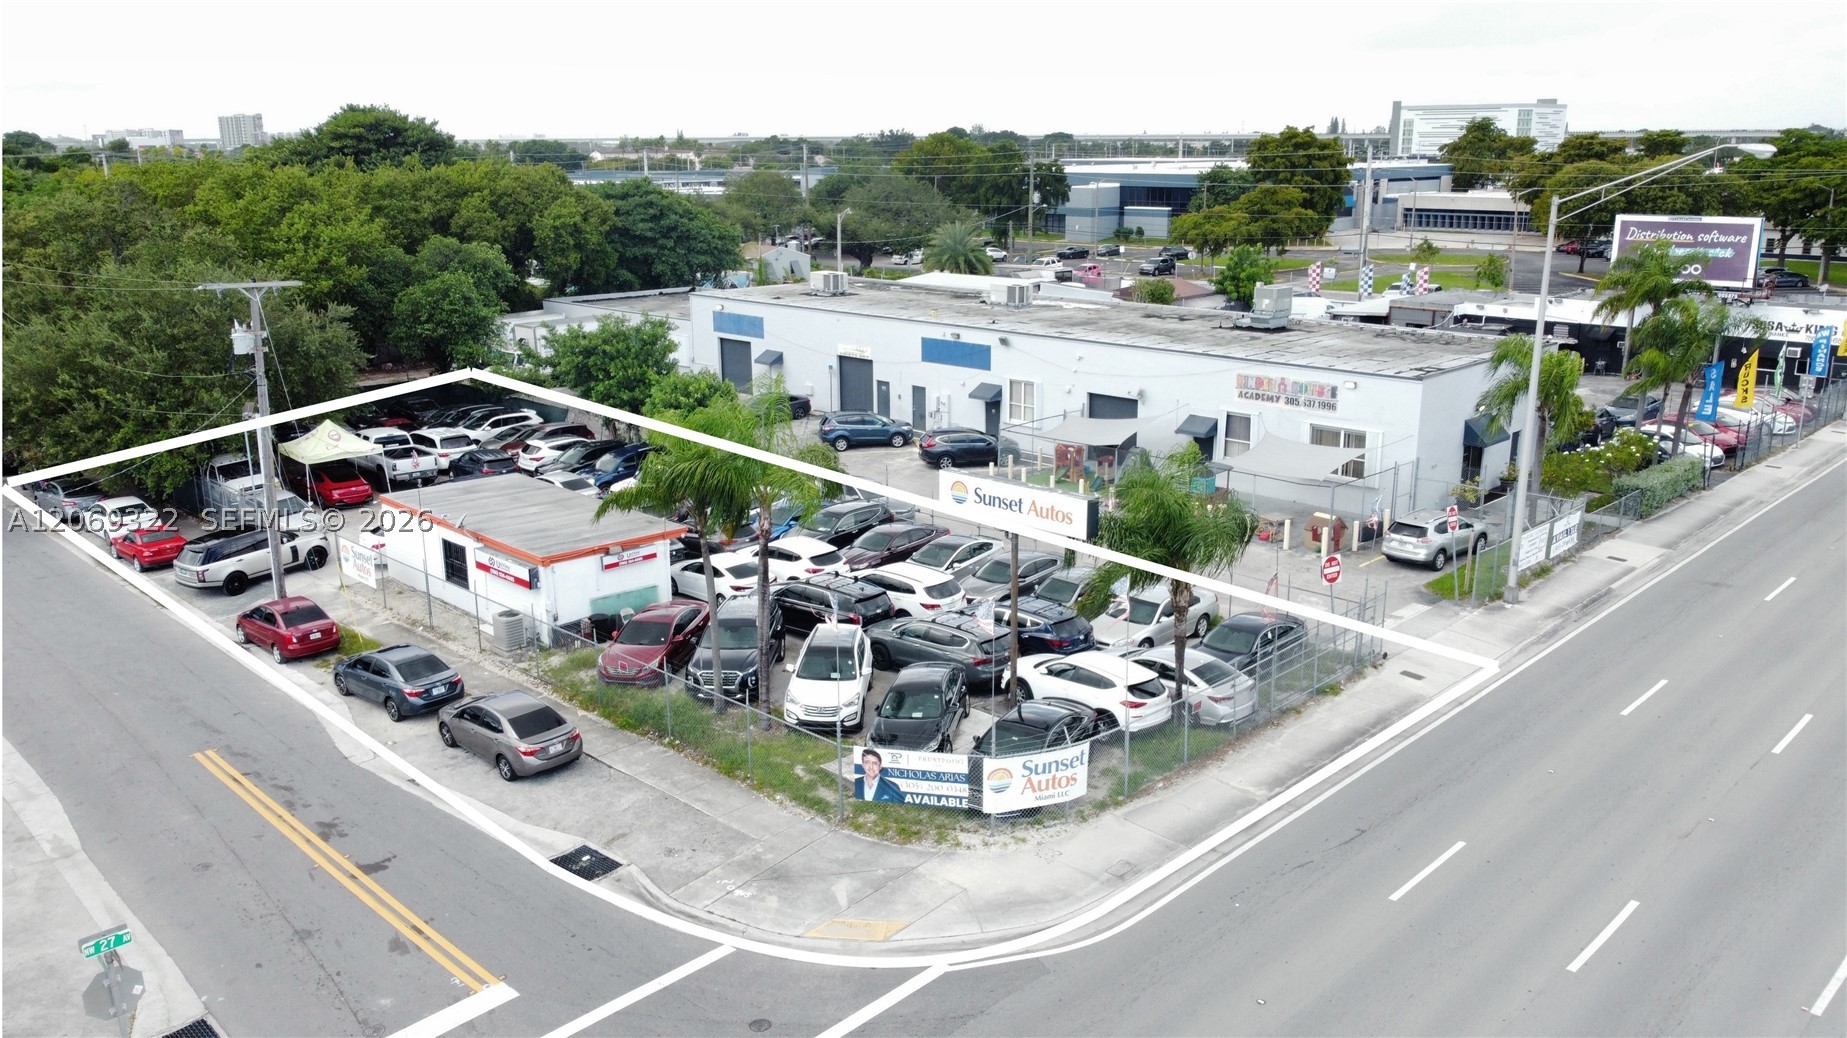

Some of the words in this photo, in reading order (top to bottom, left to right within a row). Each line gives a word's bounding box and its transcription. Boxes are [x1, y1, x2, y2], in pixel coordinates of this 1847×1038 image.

[1625, 226, 1694, 241] Distribution
[1697, 230, 1748, 243] software
[1767, 320, 1784, 332] SA
[1238, 390, 1282, 403] ACADEMY
[974, 487, 1023, 514] Sunset
[1027, 500, 1073, 525] Autos
[351, 545, 374, 567] Sunset
[353, 558, 372, 578] Autos
[1021, 749, 1086, 778] Sunset
[887, 768, 937, 780] NICHOLAS
[938, 773, 966, 782] ARIAS
[1021, 772, 1078, 795] Autos
[904, 793, 969, 809] AVAILABLE
[1034, 792, 1056, 801] Miami
[1057, 790, 1071, 798] LLC
[84, 946, 95, 956] NW
[100, 936, 115, 951] 27
